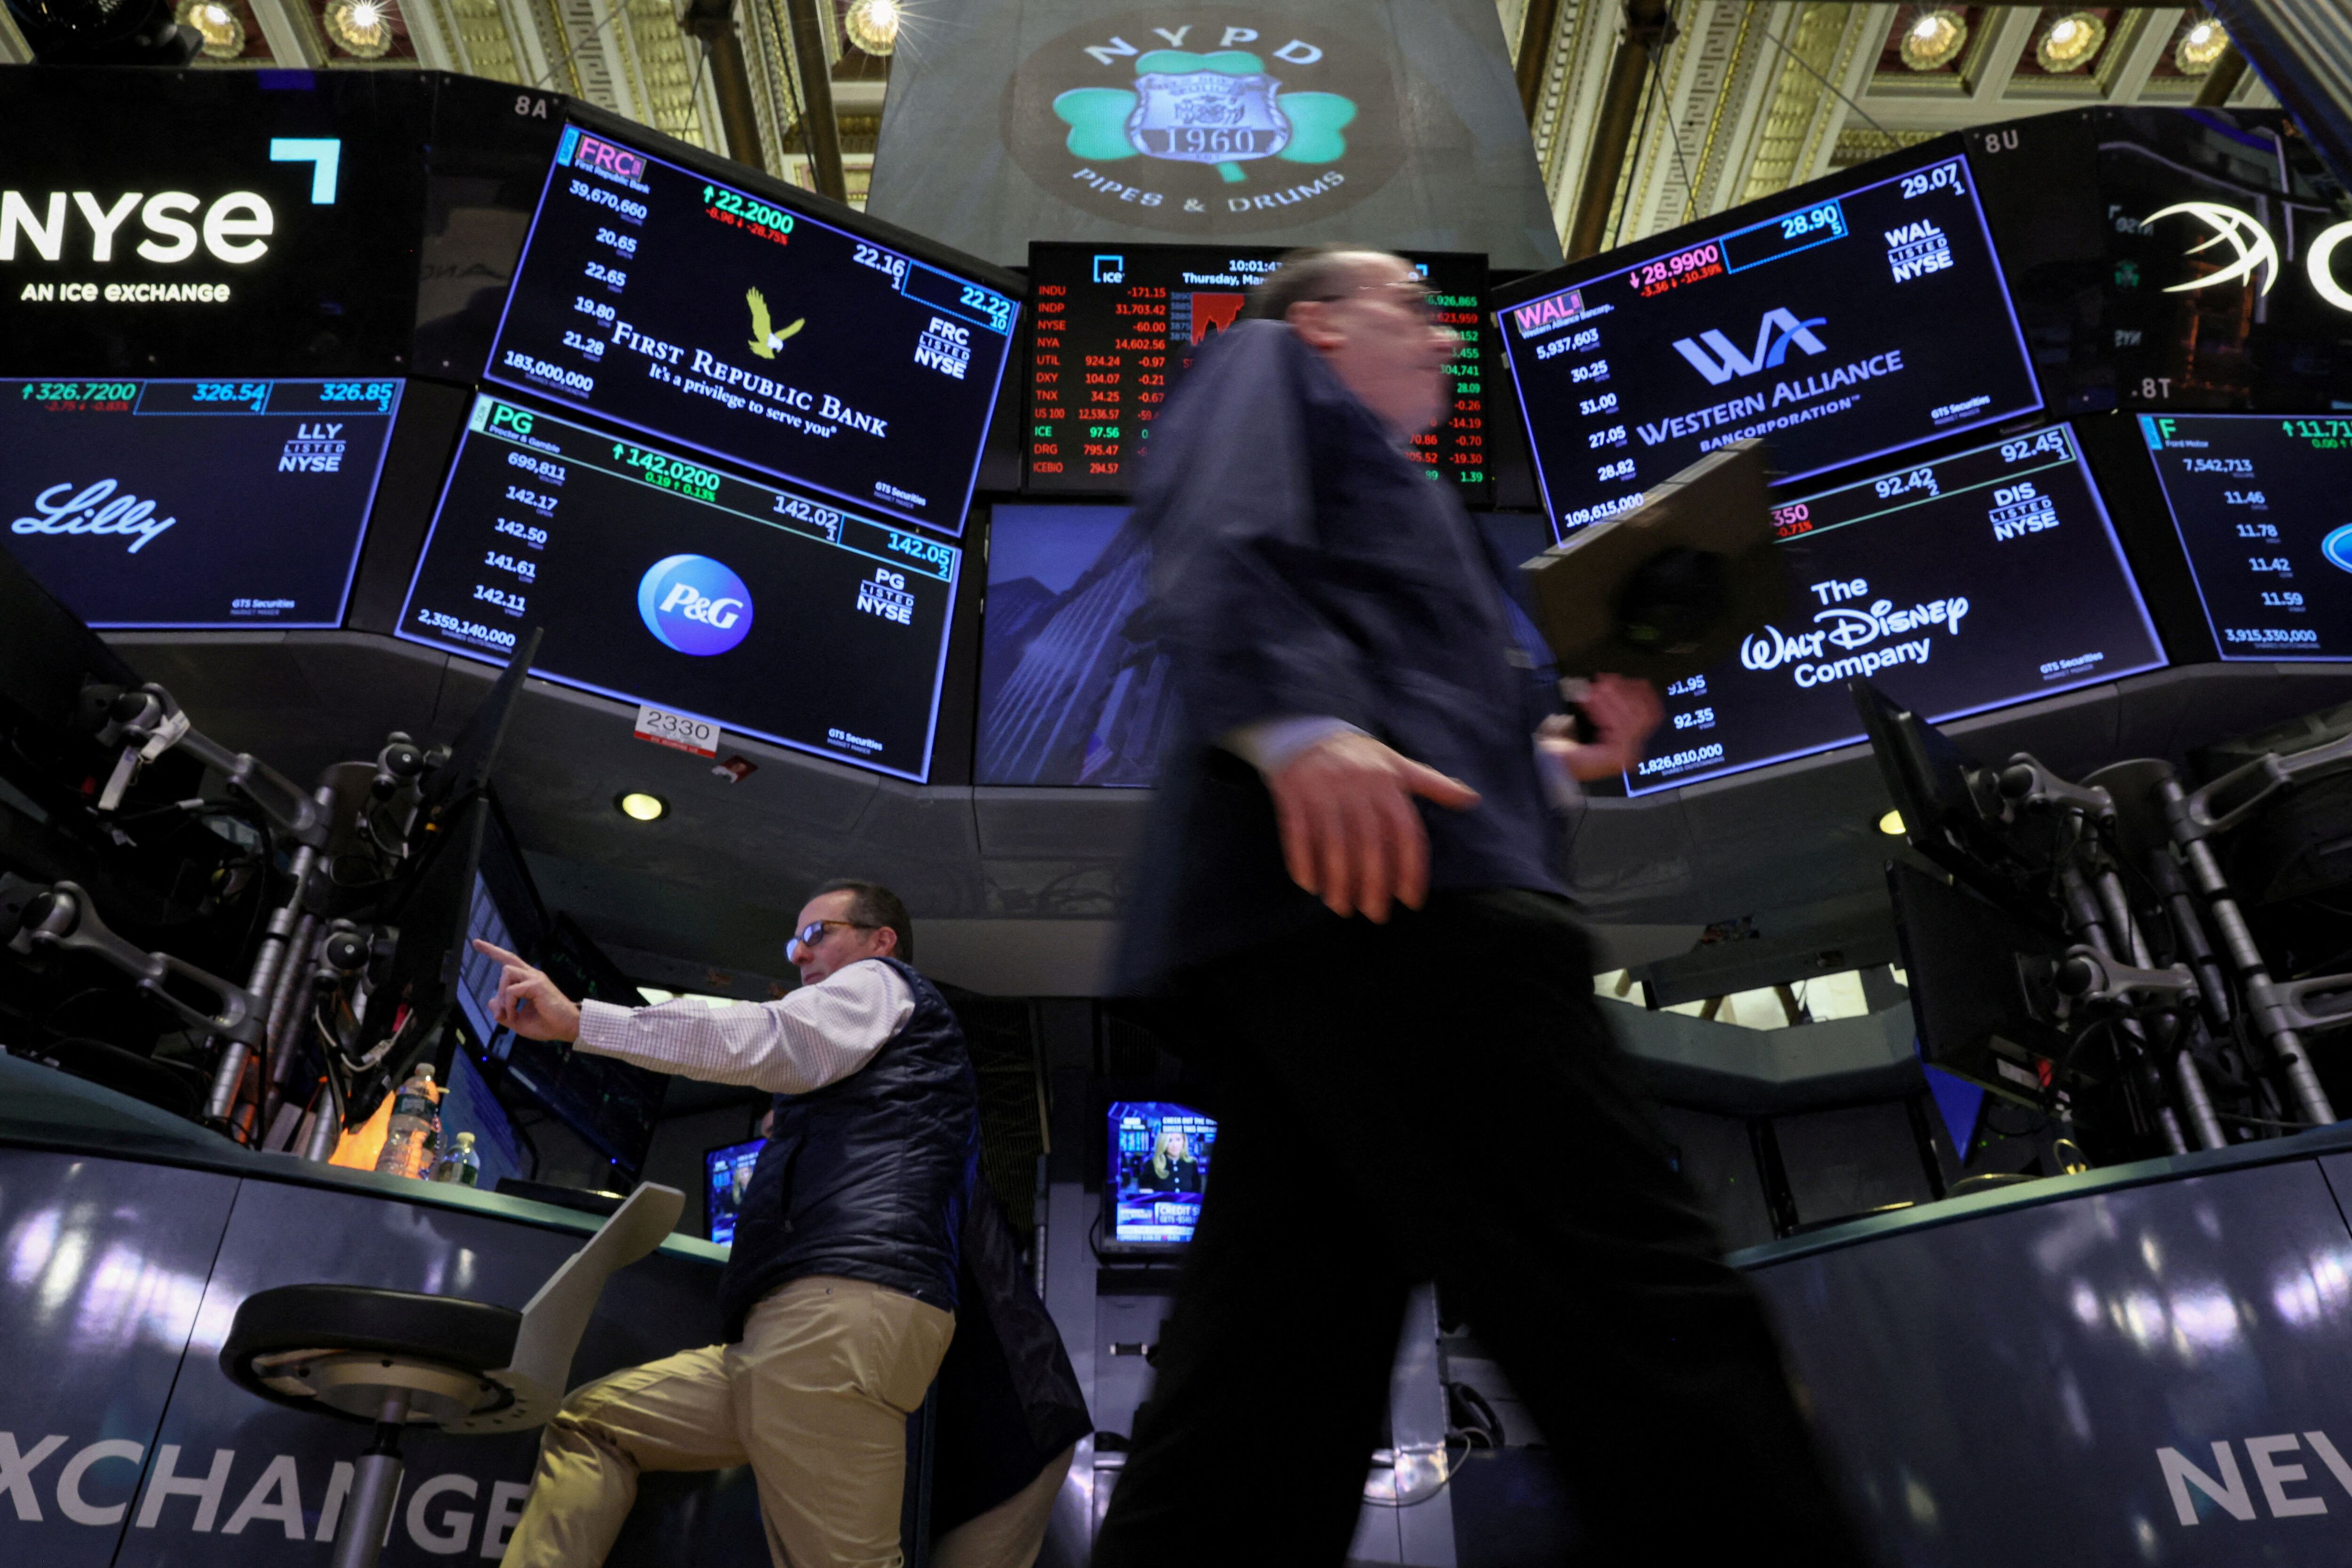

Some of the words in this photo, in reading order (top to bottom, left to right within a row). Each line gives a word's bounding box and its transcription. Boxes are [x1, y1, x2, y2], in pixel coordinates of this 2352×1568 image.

[1084, 25, 1323, 65] NYPD
[515, 95, 547, 119] 8A
[1167, 127, 1255, 154] 1960
[1985, 130, 2019, 154] 8U
[579, 136, 634, 175] FRC
[1073, 168, 1163, 207] PIPES
[1183, 198, 1207, 213] &
[1227, 170, 1345, 213] DRUMS
[1900, 163, 1958, 199] 29.07
[569, 179, 648, 219] 39,670,660
[715, 190, 794, 234] 22.2000
[1781, 206, 1838, 239] 28.90
[596, 228, 637, 253] 20.65
[1884, 219, 1941, 249] WAL
[853, 244, 906, 277] 22.16
[1888, 238, 1948, 264] LISTED
[585, 262, 627, 287] 22.65
[1642, 245, 1719, 286] 28.9900
[1891, 249, 1955, 284] NYSE
[1039, 285, 1067, 296] INDU
[1127, 287, 1166, 298] -171.15
[1182, 272, 1240, 286] Thursday,
[21, 283, 54, 302] AN
[960, 286, 1011, 318] 22.22
[574, 296, 615, 321] 19.80
[1038, 302, 1065, 313] INDP
[1516, 295, 1574, 329] WAL
[929, 317, 970, 346] FRC
[990, 317, 1007, 331] 10
[1038, 320, 1067, 331] NYSE
[1132, 322, 1166, 333] -60.00
[563, 331, 605, 356] 21.28
[919, 334, 970, 361] LISTED
[1037, 337, 1060, 348] NYA
[1536, 327, 1599, 360] 5,937,603
[504, 350, 594, 392] 183,000,000
[914, 347, 967, 380] NYSE
[1036, 355, 1061, 366] UTIL
[1085, 356, 1121, 367] 924.24
[1138, 356, 1166, 367] -0.97
[1571, 360, 1609, 383] 30.25
[1036, 372, 1059, 383] DXY
[1085, 373, 1120, 384] 104.07
[1138, 374, 1165, 385] -0.21
[2141, 378, 2171, 399] 8T
[36, 382, 136, 401] 326.7200
[192, 383, 267, 402] 326.54
[320, 383, 393, 402] 326.85
[649, 363, 671, 383] It's
[673, 374, 682, 388] a
[683, 377, 746, 409] privilege
[748, 400, 764, 414] to
[766, 406, 803, 428] serve
[1036, 390, 1058, 401] TNX
[1091, 391, 1120, 402] 34.25
[1137, 392, 1165, 403] -0.67
[1049, 408, 1065, 419] 100
[1454, 400, 1481, 411] -0.26
[1579, 393, 1617, 416] 31.00
[298, 423, 343, 439] LLY
[493, 404, 534, 435] PG
[1034, 426, 1053, 437] ICE
[1089, 427, 1120, 438] 97.56
[1448, 418, 1481, 428] -14.19
[2158, 419, 2177, 439] F
[2296, 420, 2352, 437] 11.71
[283, 444, 346, 453] LISTED
[1034, 444, 1058, 455] DRG
[1083, 444, 1120, 455] 795.47
[1455, 436, 1482, 446] -0.70
[1589, 425, 1626, 449] 27.05
[2000, 431, 2065, 463] 92.45
[278, 456, 341, 472] NYSE
[508, 451, 566, 481] 699,811
[626, 447, 720, 491] 142.0200
[1089, 462, 1120, 474] 294.57
[1449, 453, 1483, 465] -19.30
[1597, 458, 1636, 482] 28.82
[2182, 458, 2253, 473] 7,542,713
[645, 471, 671, 488] 0.19
[1461, 471, 1483, 483] 1.39
[1875, 468, 1937, 499] 92.42
[505, 485, 558, 511] 142.17
[1994, 483, 2037, 507] DIS
[2224, 491, 2266, 505] 11.46
[11, 478, 176, 554] Lilly
[773, 495, 839, 530] 142.02
[1565, 492, 1645, 529] 109,615,000
[1989, 499, 2053, 523] LISTED
[494, 518, 548, 544] 142.50
[1994, 510, 2060, 542] NYSE
[2236, 523, 2279, 538] 11.78
[888, 532, 951, 565] 142.05
[485, 551, 536, 578] 141.61
[2248, 557, 2292, 571] 11.42
[875, 567, 906, 590] PG
[473, 585, 526, 612] 142.11
[860, 583, 914, 608] LISTED
[1811, 578, 1868, 605] The
[2261, 591, 2304, 606] 11.59
[659, 581, 744, 629] P&G
[857, 595, 913, 625] NYSE
[418, 609, 516, 648] 2,359,140,000
[2224, 628, 2318, 643] 3,915,330,000
[1794, 638, 1931, 689] Company
[646, 711, 710, 740] 2330
[1673, 707, 1715, 730] 92.35
[1637, 743, 1724, 776] 1,826,810,000
